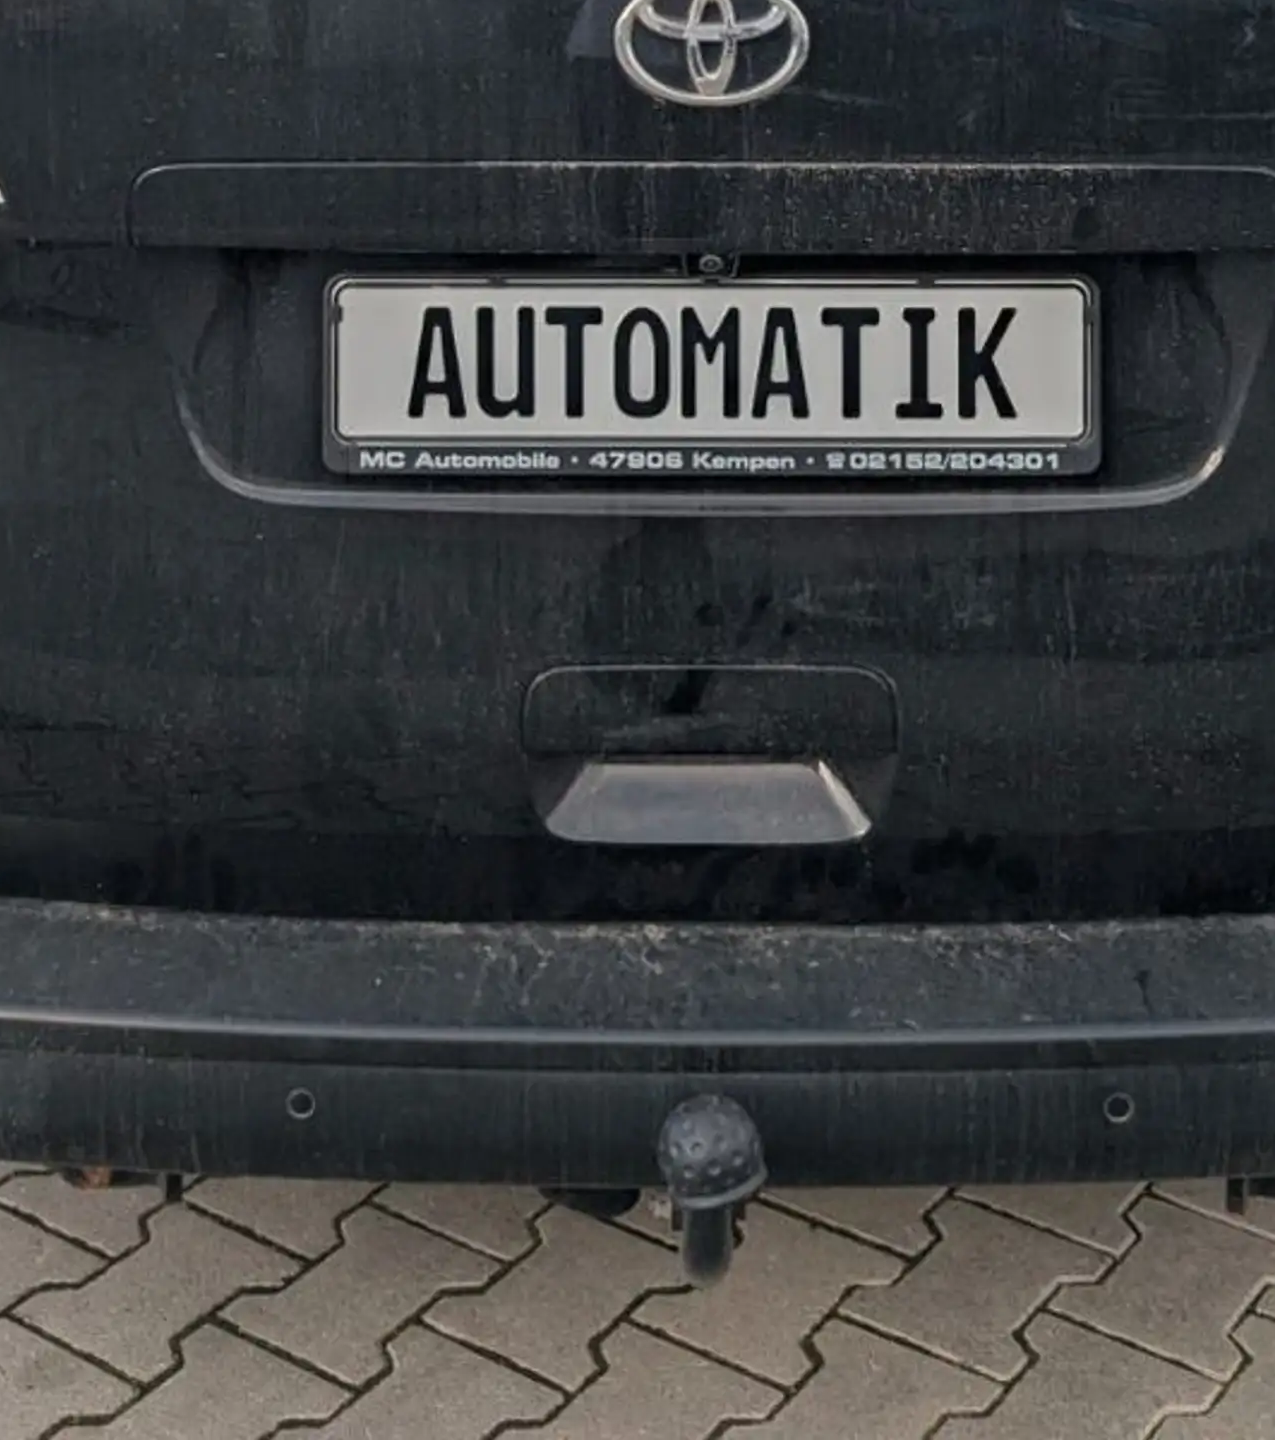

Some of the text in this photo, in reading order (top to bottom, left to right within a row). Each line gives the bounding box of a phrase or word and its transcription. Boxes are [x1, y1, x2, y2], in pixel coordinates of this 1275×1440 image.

[407, 306, 1018, 420] AUTOMATIK
[359, 450, 406, 470] MC
[414, 450, 561, 470] Automobile
[691, 451, 795, 473] Kempen
